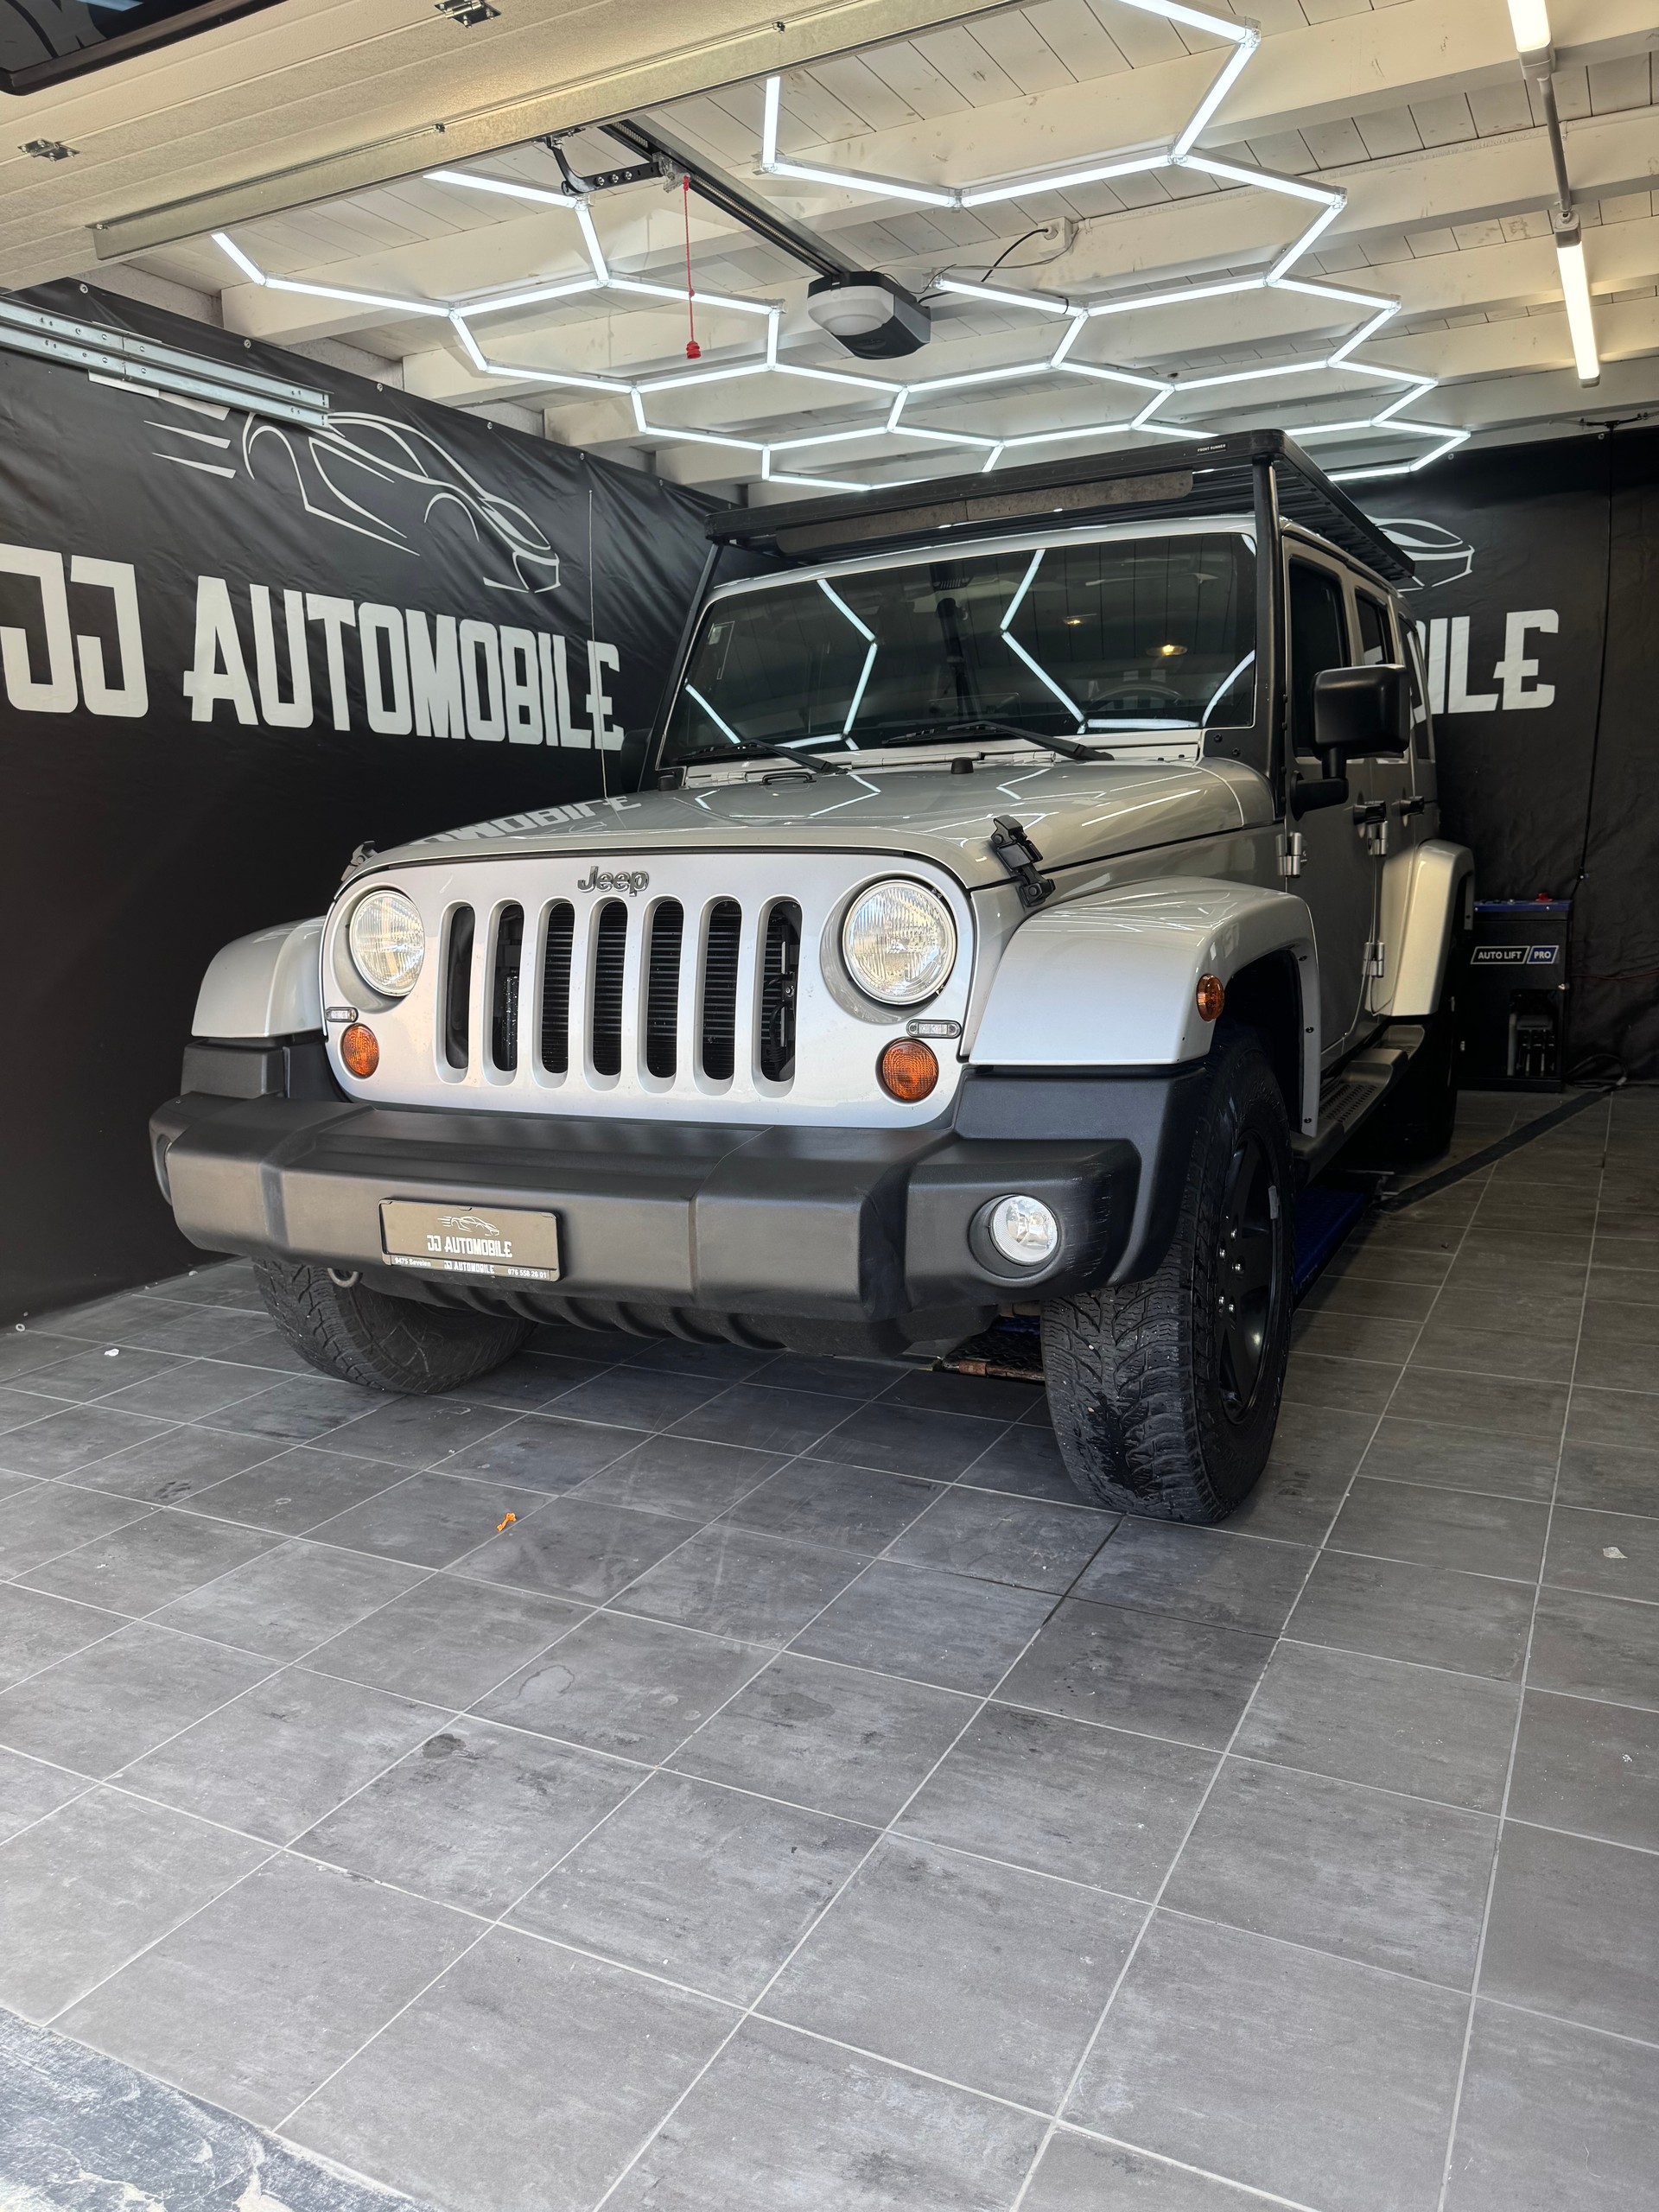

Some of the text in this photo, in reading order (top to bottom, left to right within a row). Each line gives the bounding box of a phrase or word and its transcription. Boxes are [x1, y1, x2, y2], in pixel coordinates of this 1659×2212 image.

[0, 543, 624, 751] JJ AUTOMOBILE
[577, 866, 650, 897] Jeep
[1534, 950, 1551, 959] PRO
[427, 1235, 512, 1257] JJ AUTOMOBILE
[454, 1261, 495, 1274] AUTOMOBILE
[507, 1268, 519, 1276] 076
